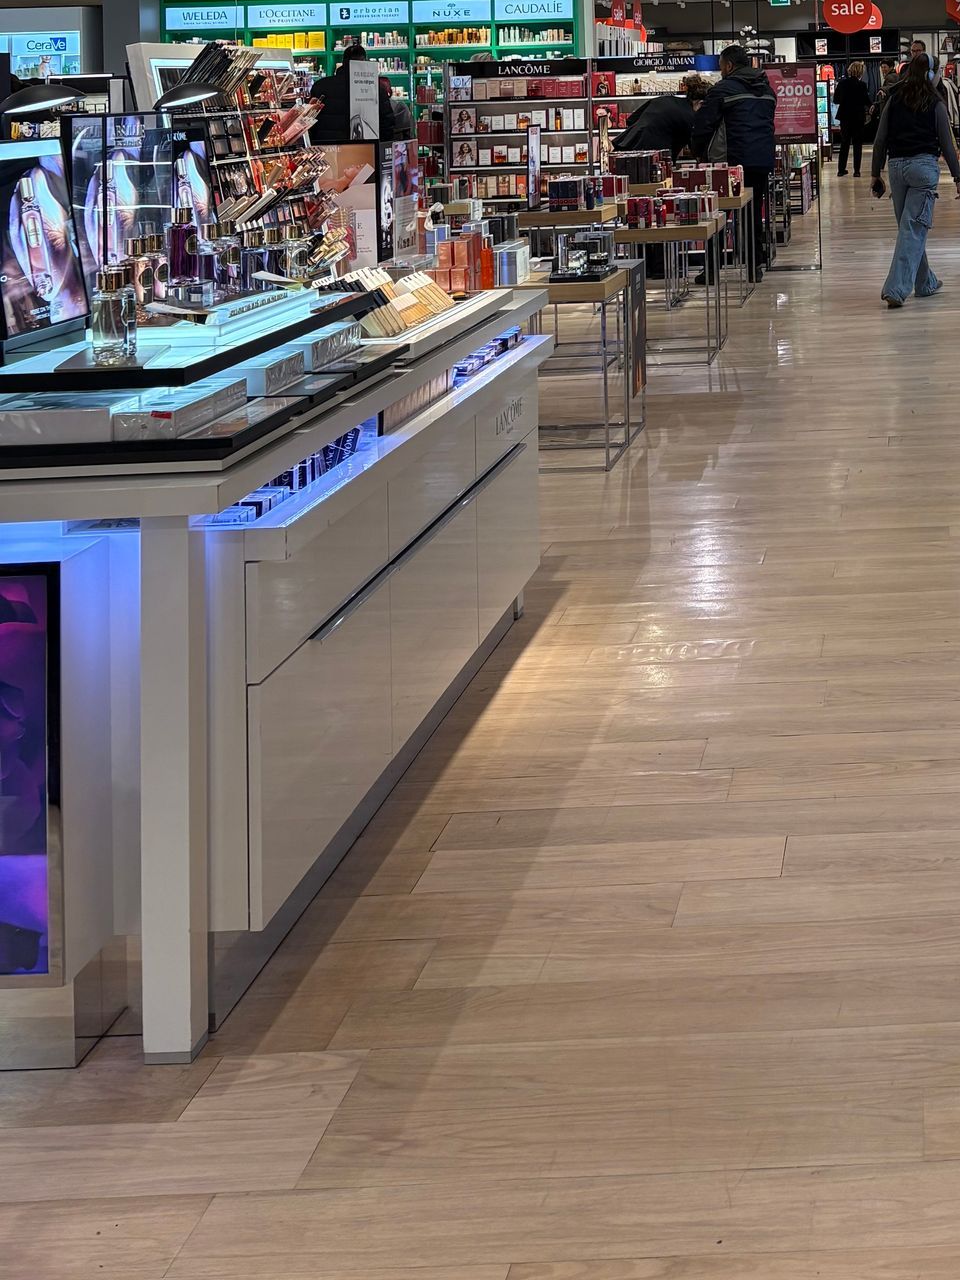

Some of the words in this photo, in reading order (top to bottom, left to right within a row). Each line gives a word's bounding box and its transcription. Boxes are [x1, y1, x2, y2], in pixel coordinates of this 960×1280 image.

[432, 9, 471, 17] NUXE
[831, 0, 865, 15] sale
[182, 11, 228, 21] WELEDA
[259, 8, 316, 19] L'OCCITANE
[26, 37, 67, 51] CeraVe
[633, 58, 664, 67] GIORGIO
[667, 57, 695, 65] ARMANI
[498, 63, 551, 75] LANCÔME
[777, 85, 813, 96] 2000
[495, 396, 524, 435] LANCÔME
